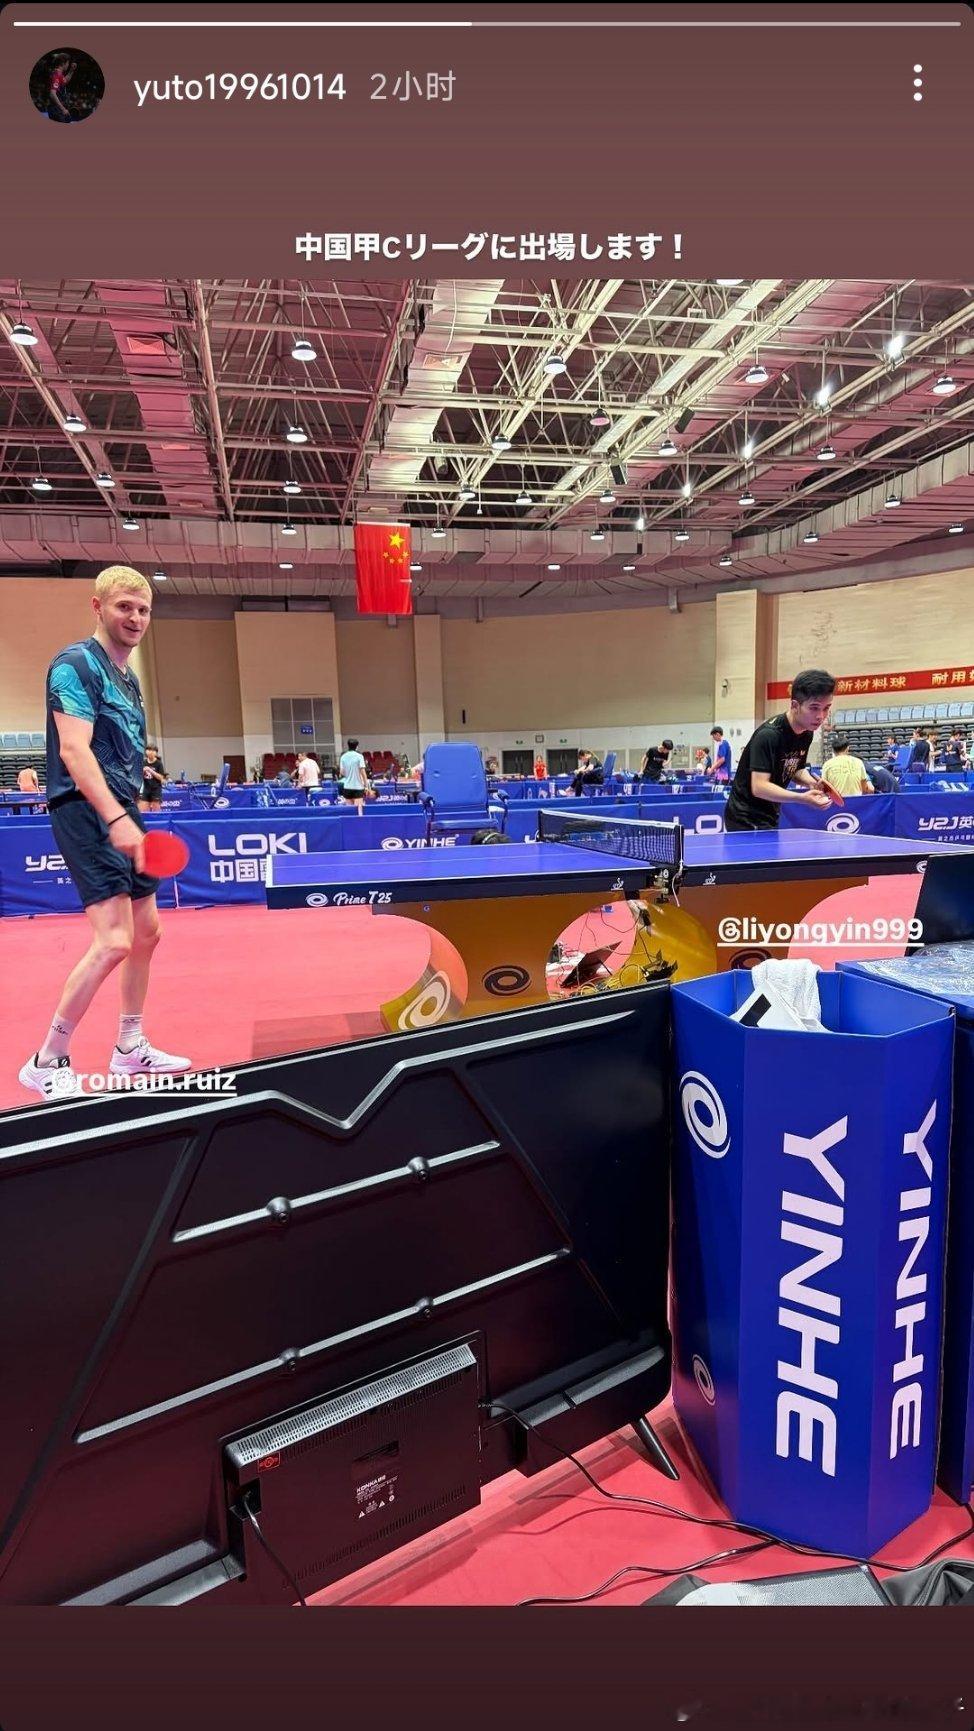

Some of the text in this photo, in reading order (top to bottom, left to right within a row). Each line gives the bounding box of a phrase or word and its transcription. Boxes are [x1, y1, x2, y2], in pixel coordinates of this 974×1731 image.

[208, 832, 308, 856] LOKI
[209, 858, 267, 883] 中国
[333, 892, 366, 906] Prime
[890, 1099, 937, 1460] YINHE
[776, 1115, 848, 1478] YINHE
